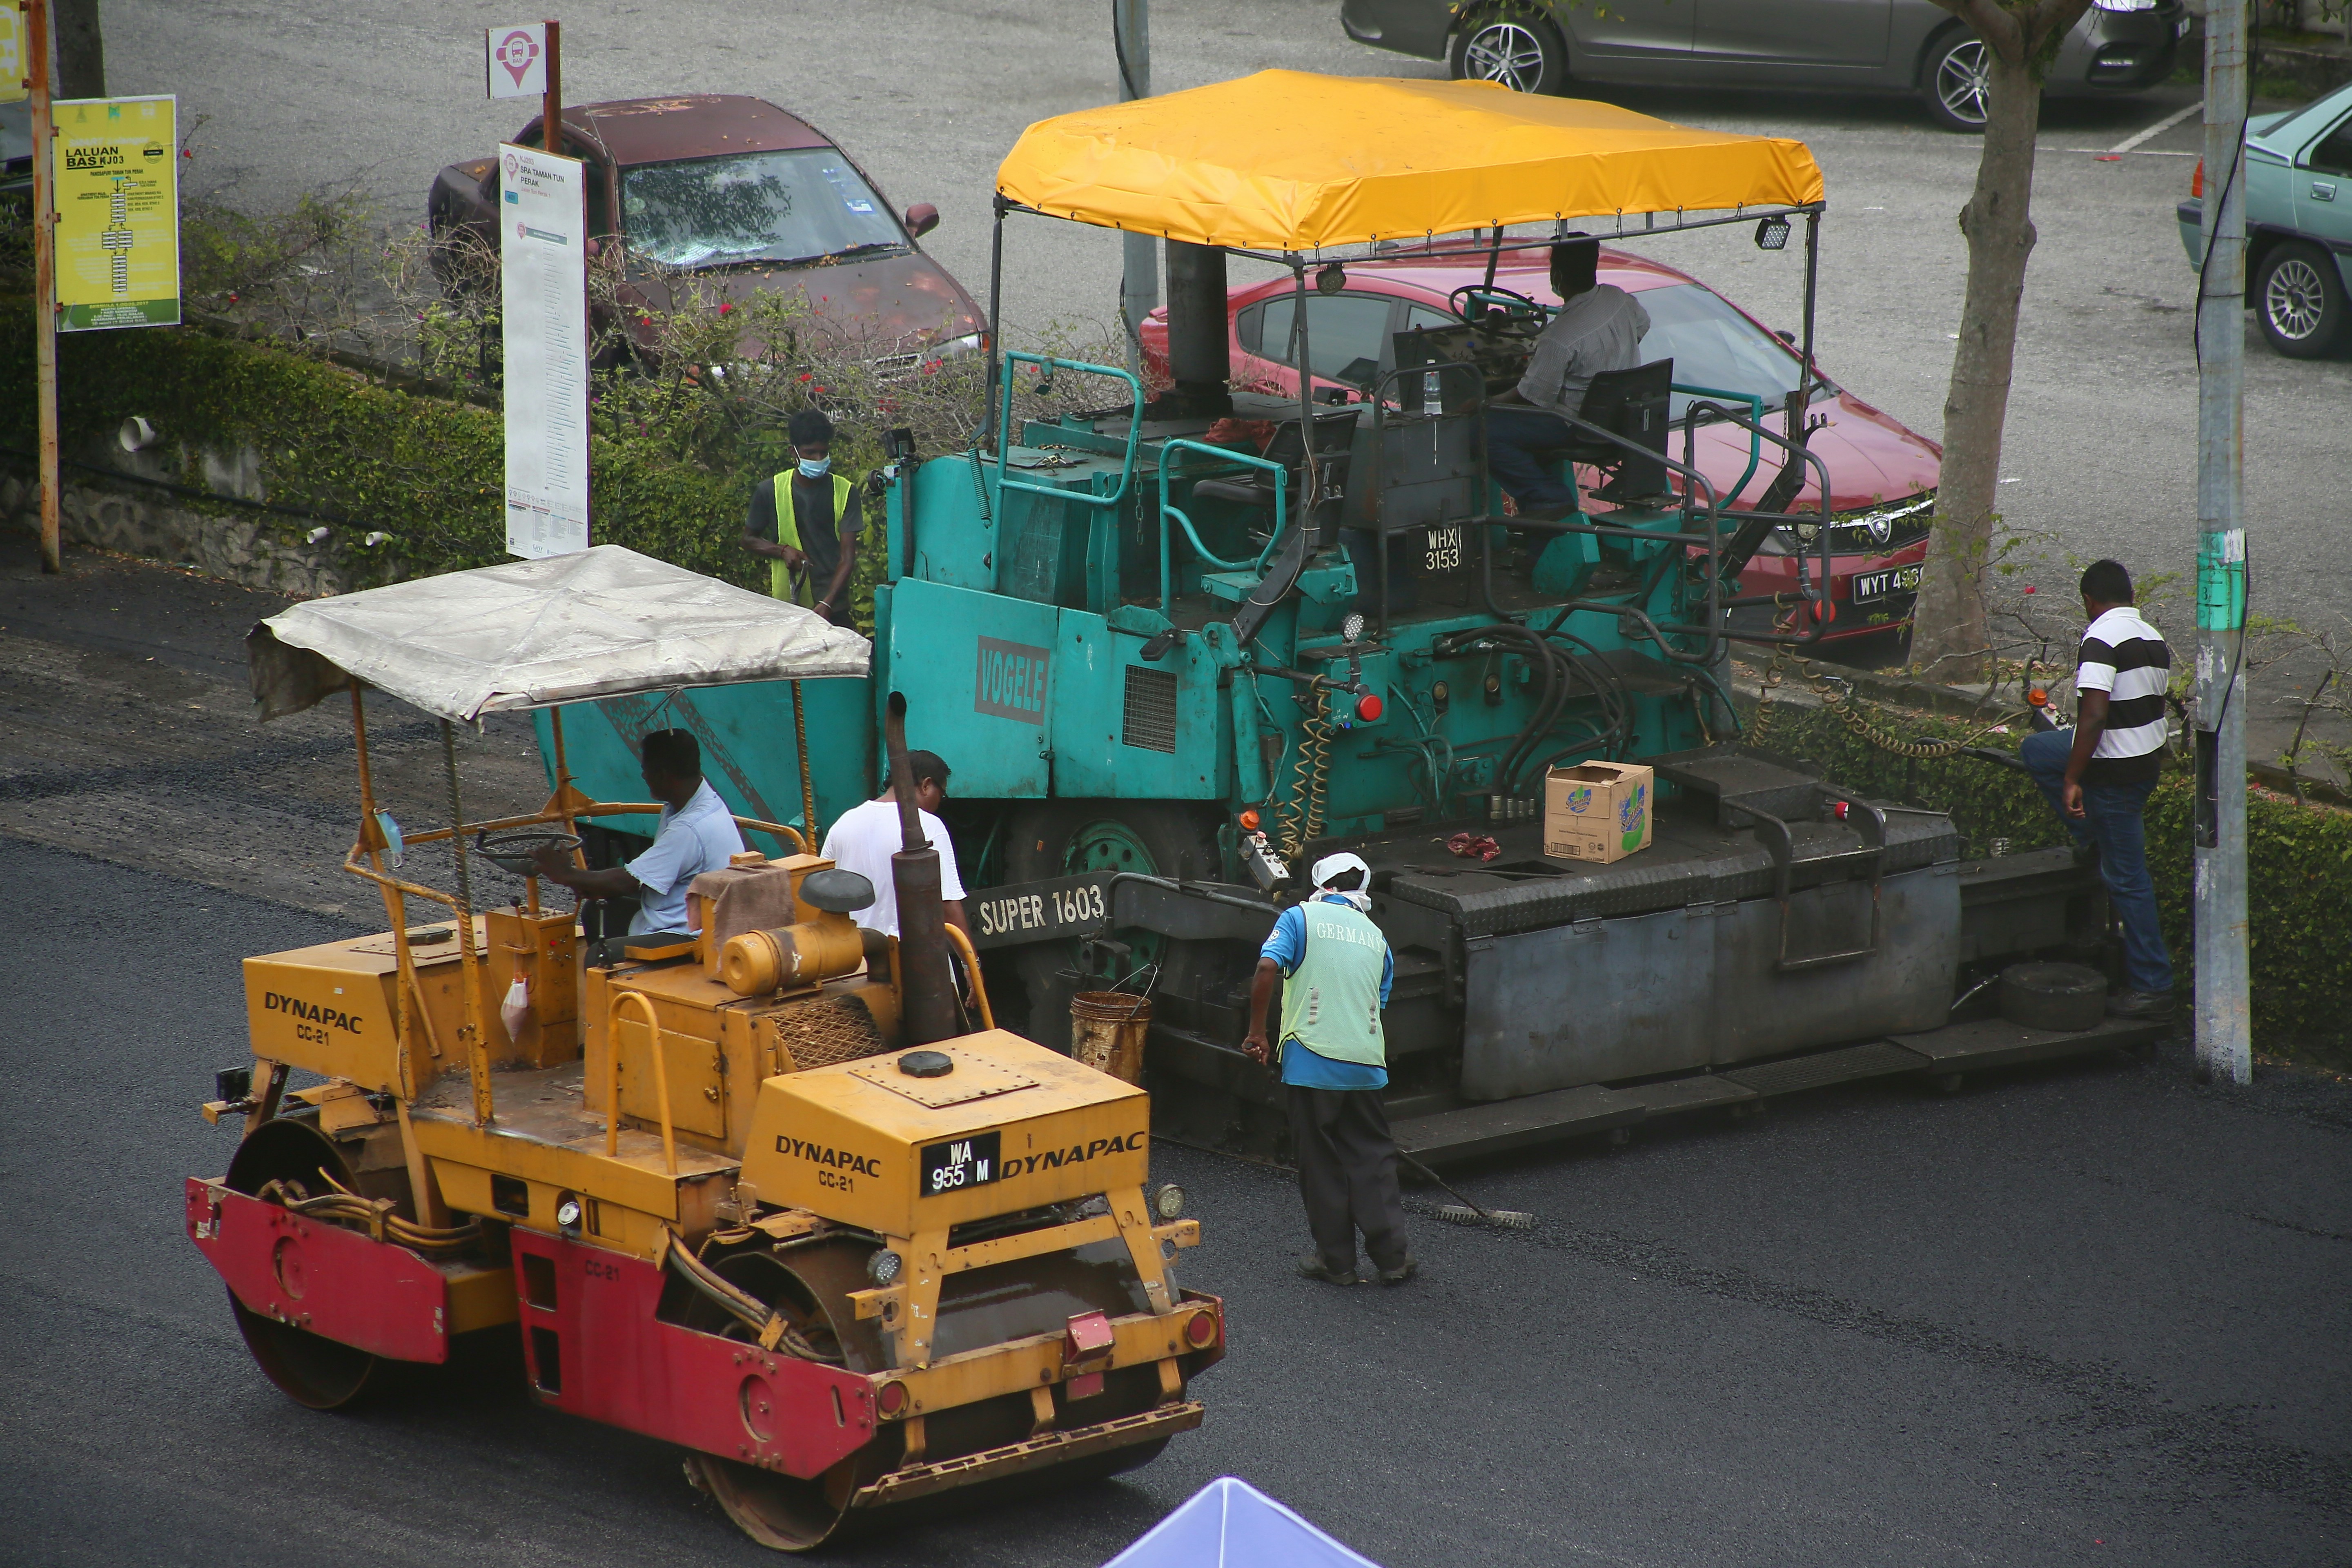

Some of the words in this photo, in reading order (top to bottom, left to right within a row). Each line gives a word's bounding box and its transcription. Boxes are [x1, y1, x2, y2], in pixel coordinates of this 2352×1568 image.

[66, 147, 118, 157] LALUAN
[67, 156, 97, 167] BAS
[100, 156, 124, 165] KJ03
[520, 166, 532, 175] SRA
[532, 169, 552, 180] TAMAN
[552, 174, 564, 183] TUN
[521, 176, 539, 187] PERAK
[1428, 528, 1456, 550] WHX
[1426, 549, 1459, 570] 3153
[1861, 574, 1889, 596] WYT
[982, 648, 1044, 712] VOGELE
[1566, 796, 1589, 809] Summer
[980, 895, 1046, 935] SUPER
[1052, 884, 1104, 924] 1603
[1317, 922, 1383, 952] GERMANY
[265, 991, 363, 1034] DYNAPAC
[776, 1135, 882, 1178] DYNAPAC
[950, 1141, 972, 1165] WA
[1001, 1131, 1145, 1180] DYNAPAC
[932, 1164, 964, 1190] 955
[976, 1159, 988, 1182] M
